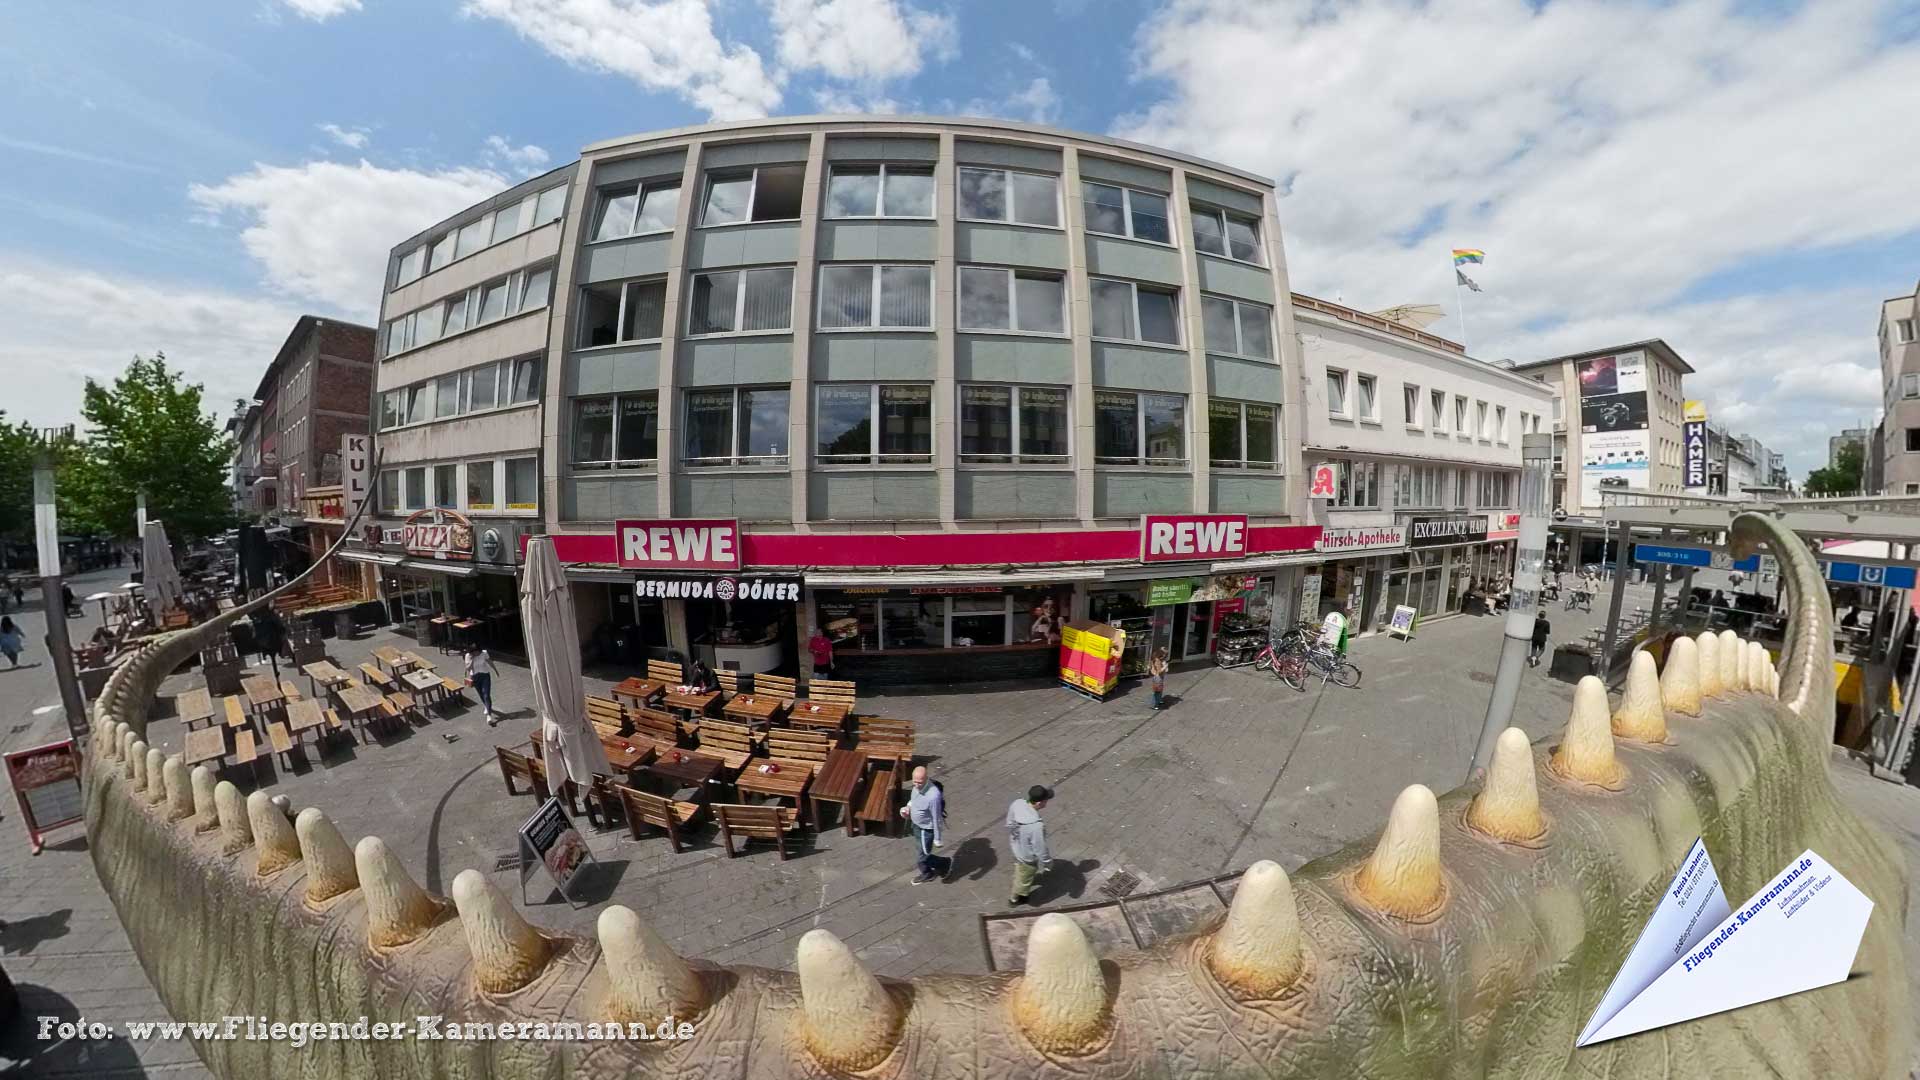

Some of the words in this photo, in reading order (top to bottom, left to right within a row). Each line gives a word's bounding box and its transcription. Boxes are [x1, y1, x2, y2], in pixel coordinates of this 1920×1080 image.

[1689, 423, 1704, 485] HAMER
[350, 437, 365, 512] KULT
[405, 526, 450, 550] PIZZA
[1150, 521, 1244, 555] REWE
[1323, 529, 1401, 549] Hirsch-Apotheke
[1414, 520, 1467, 538] EXCELLENCE
[1469, 519, 1487, 534] HAIR
[623, 527, 735, 562] REWE
[635, 580, 714, 599] BERMUDA
[738, 579, 800, 601] DÖNER
